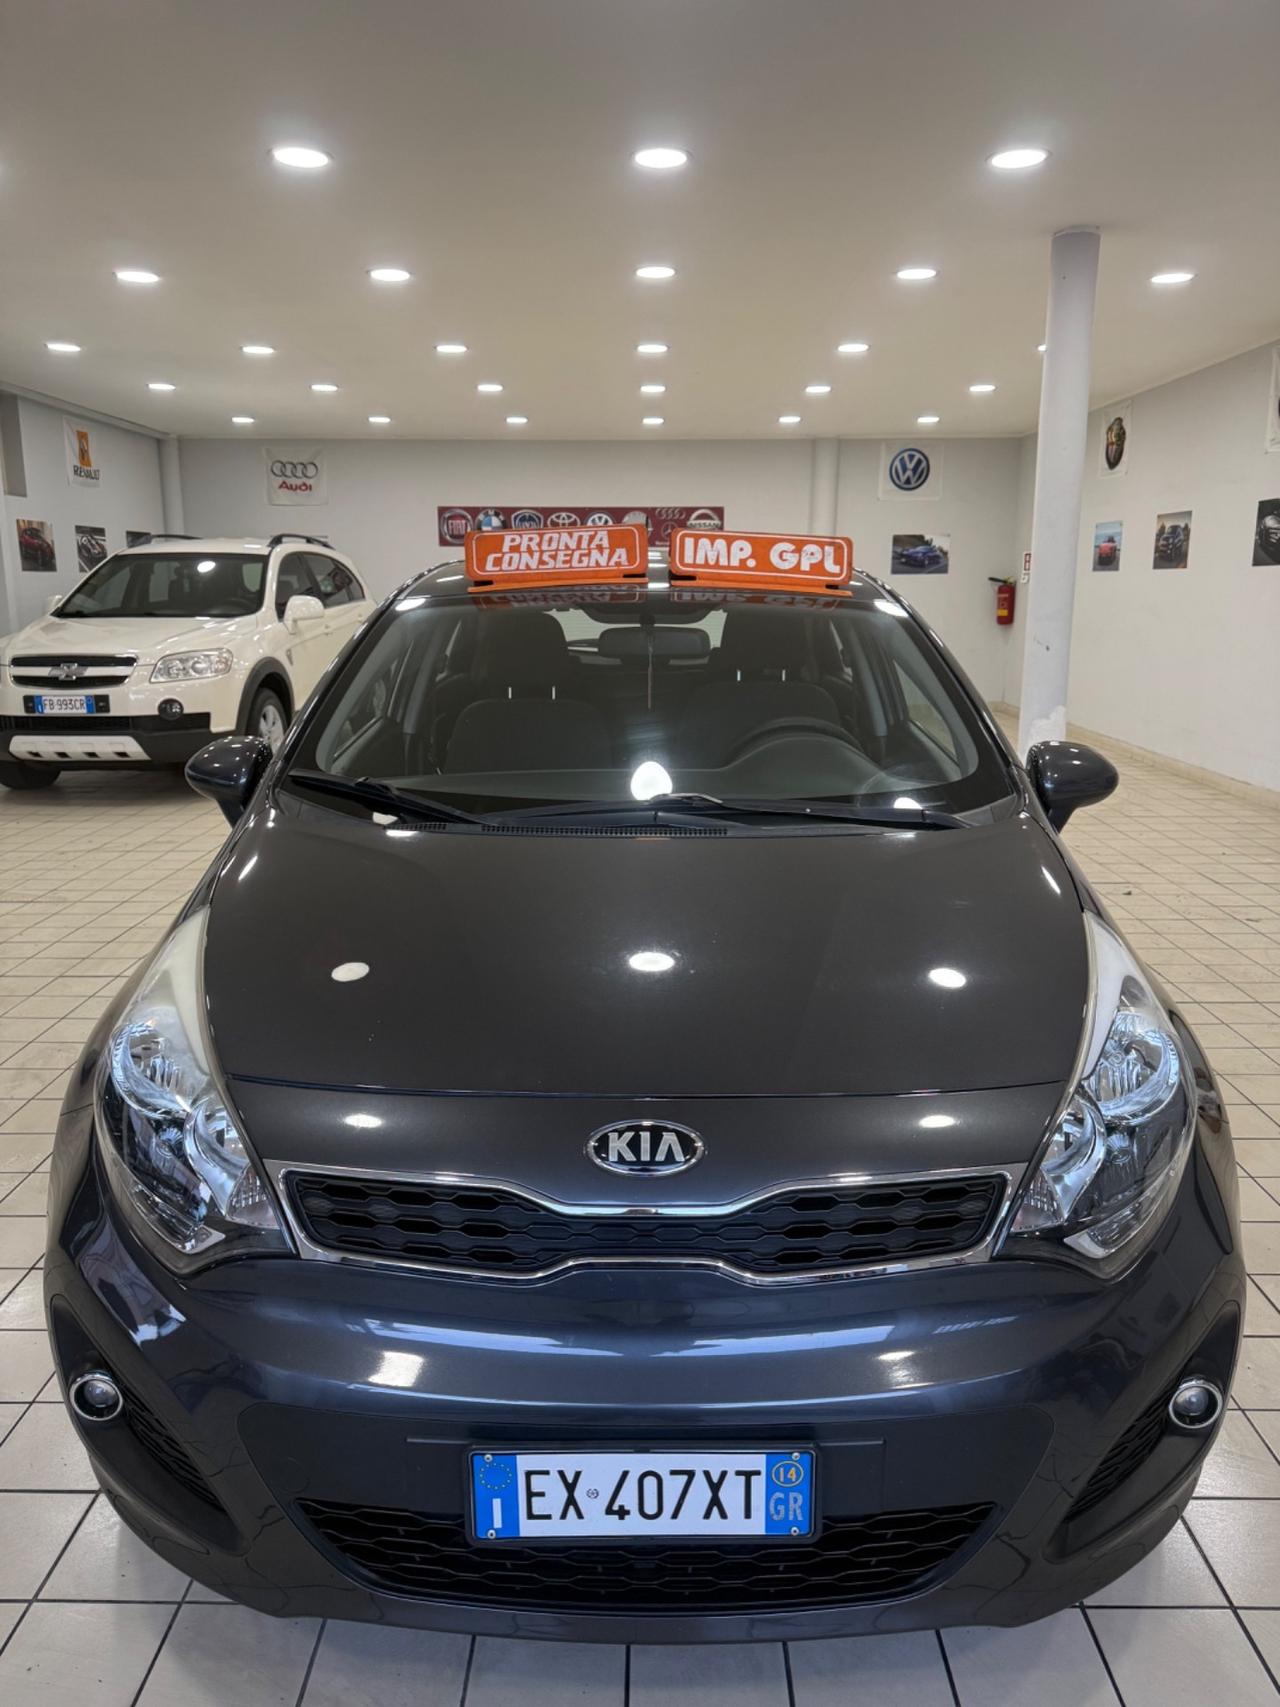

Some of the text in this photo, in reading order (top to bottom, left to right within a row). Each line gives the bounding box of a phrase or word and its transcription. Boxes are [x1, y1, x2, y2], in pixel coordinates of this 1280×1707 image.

[278, 480, 313, 493] Audi
[448, 520, 466, 535] FIAT
[501, 530, 610, 553] PRONTA
[484, 548, 629, 572] CONSEGNA
[683, 537, 841, 573] IMP. GPL
[607, 1131, 685, 1162] KIA
[768, 1491, 804, 1522] GR
